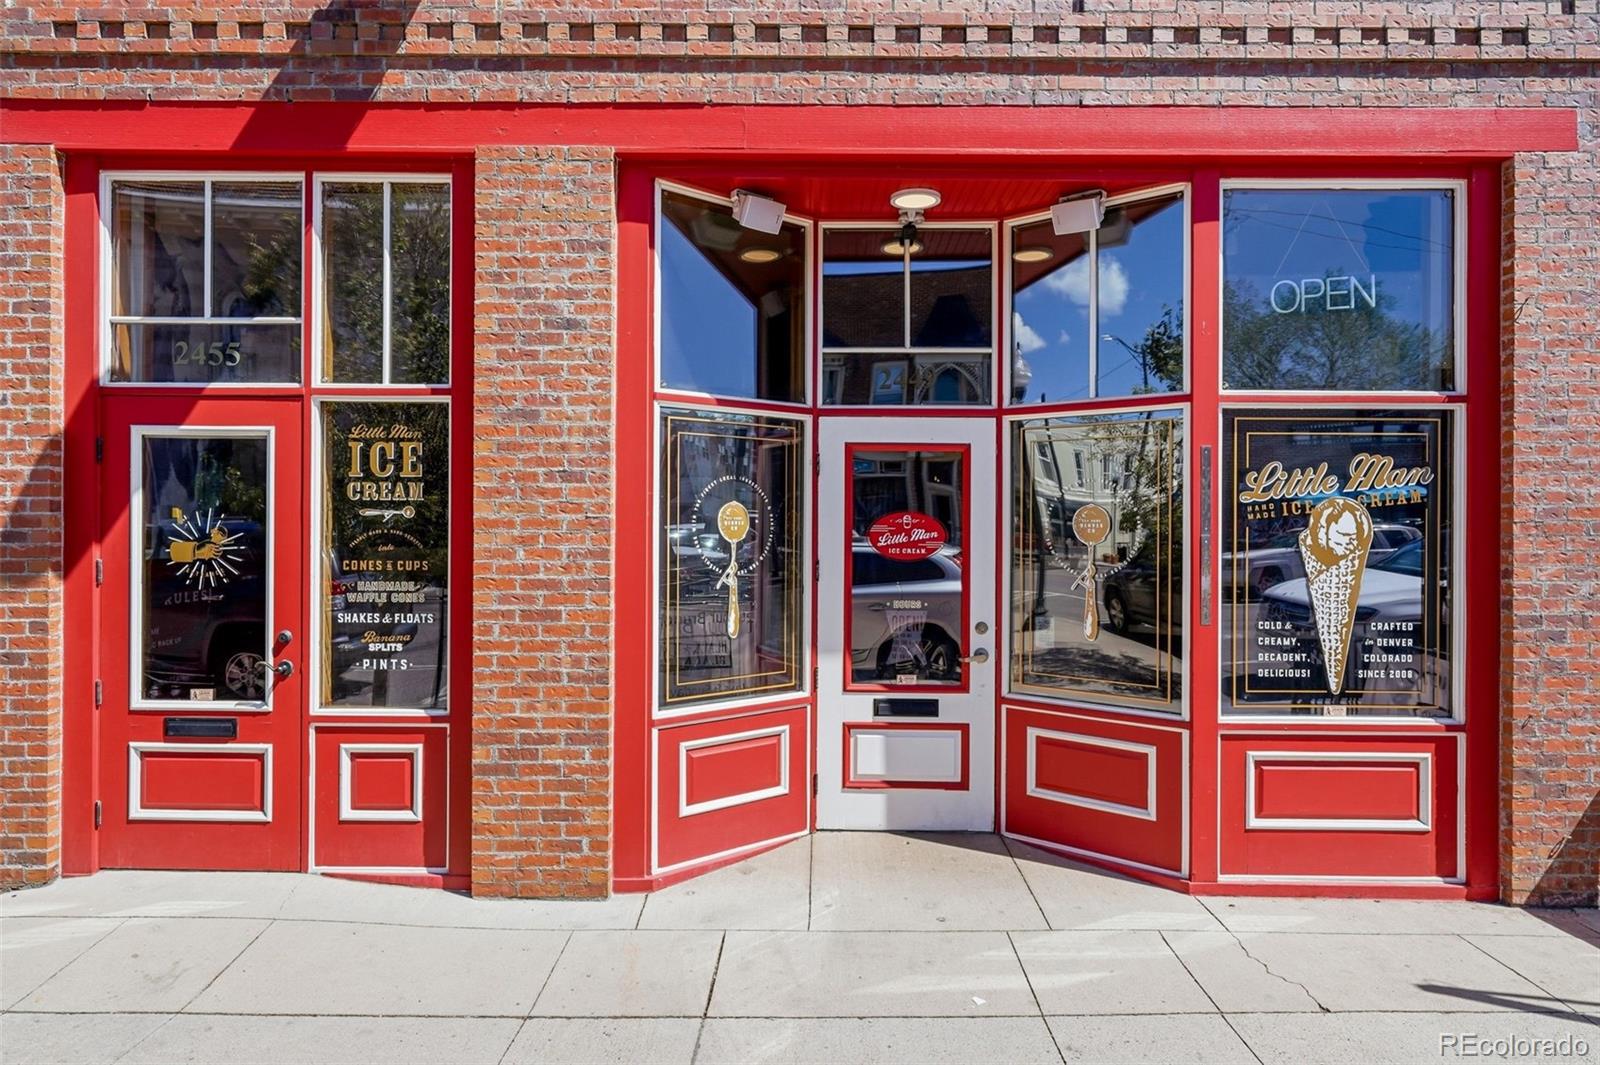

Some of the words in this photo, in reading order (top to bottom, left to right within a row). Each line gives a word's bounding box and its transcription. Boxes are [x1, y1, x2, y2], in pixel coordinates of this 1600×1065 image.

[1270, 274, 1376, 314] OPEN
[174, 341, 241, 367] 2455
[348, 424, 387, 439] Little
[389, 424, 422, 439] Man
[348, 441, 423, 478] ICE
[1239, 461, 1340, 503] Little
[1342, 453, 1435, 493] Man
[346, 482, 425, 501] CREAM
[1246, 503, 1275, 512] HAND
[1282, 500, 1313, 517] ICE
[1357, 490, 1424, 508] CREAM
[1247, 510, 1276, 520] MADE
[877, 532, 909, 547] Little
[910, 528, 938, 541] Man
[343, 560, 383, 571] CONES
[397, 560, 429, 571] CUPS
[357, 581, 415, 591] HANDMADE
[346, 592, 387, 603] WAFFLE
[390, 592, 425, 603] CONES
[338, 613, 380, 623] SHAKES
[382, 613, 393, 623] &
[394, 613, 434, 623] FLOATS
[1258, 621, 1282, 630] COLD
[1284, 621, 1293, 630] &
[1371, 622, 1414, 631] CRAFTED
[361, 630, 412, 643] Banana
[368, 643, 403, 652] SPLITS
[1377, 638, 1413, 647] DENVER
[1364, 654, 1413, 663] COLORADO
[363, 659, 408, 670] PINTS
[1258, 669, 1311, 678] DELICIOUS!
[1358, 669, 1386, 678] SINCE
[1389, 669, 1413, 679] 2008
